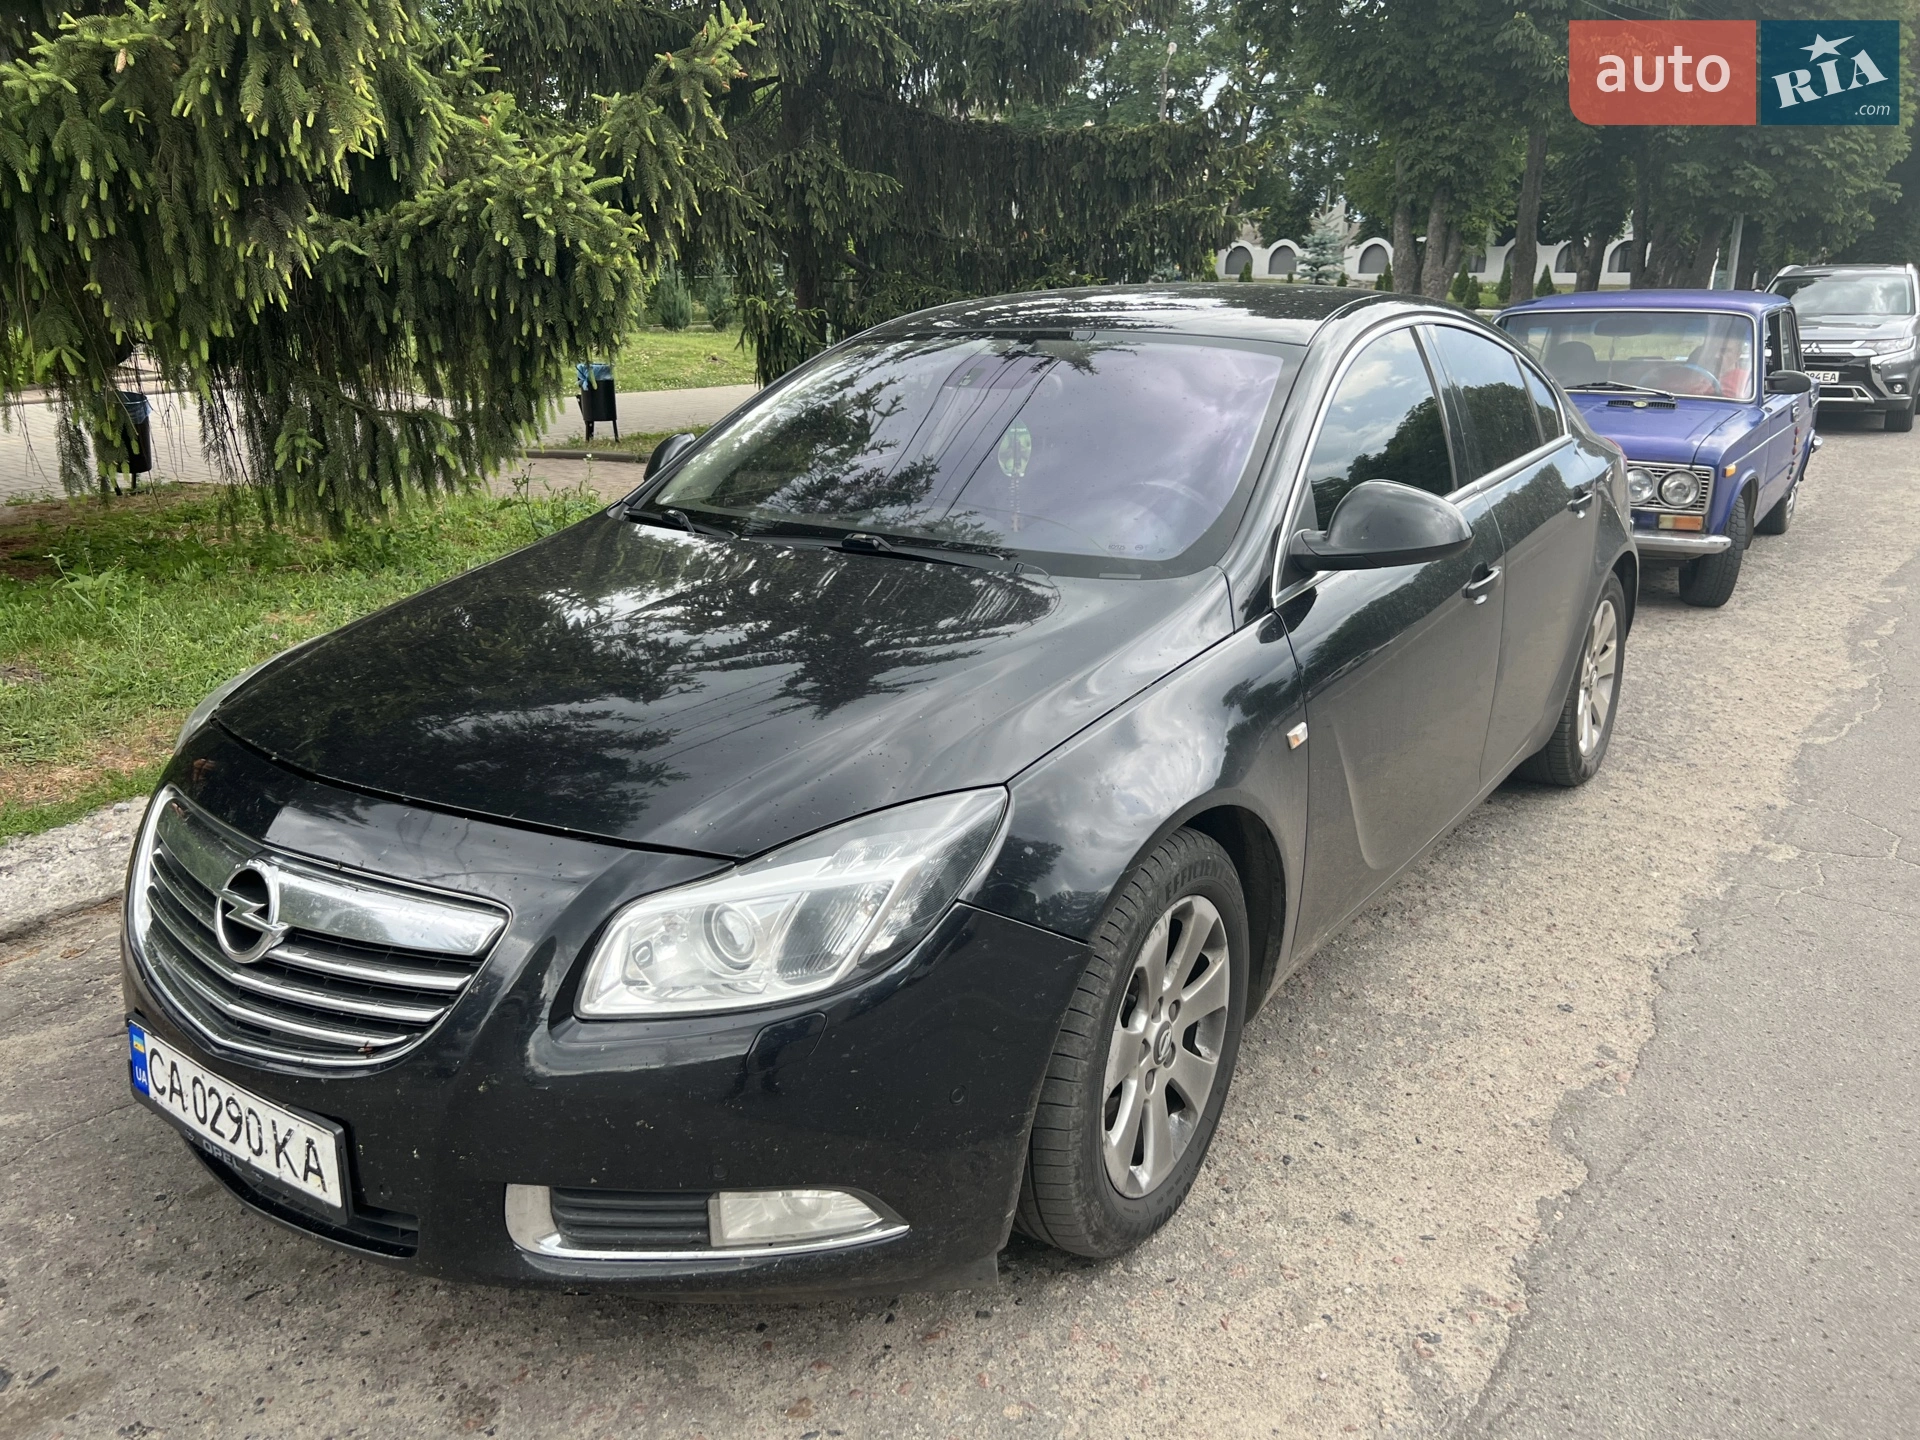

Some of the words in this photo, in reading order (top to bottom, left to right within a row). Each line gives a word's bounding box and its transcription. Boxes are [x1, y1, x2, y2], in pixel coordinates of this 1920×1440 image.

[1822, 373, 1836, 381] EA
[135, 1065, 148, 1086] UA
[149, 1047, 188, 1113] CA
[192, 1075, 263, 1157] 0290
[271, 1119, 328, 1193] KA
[202, 1140, 243, 1172] OPEL
